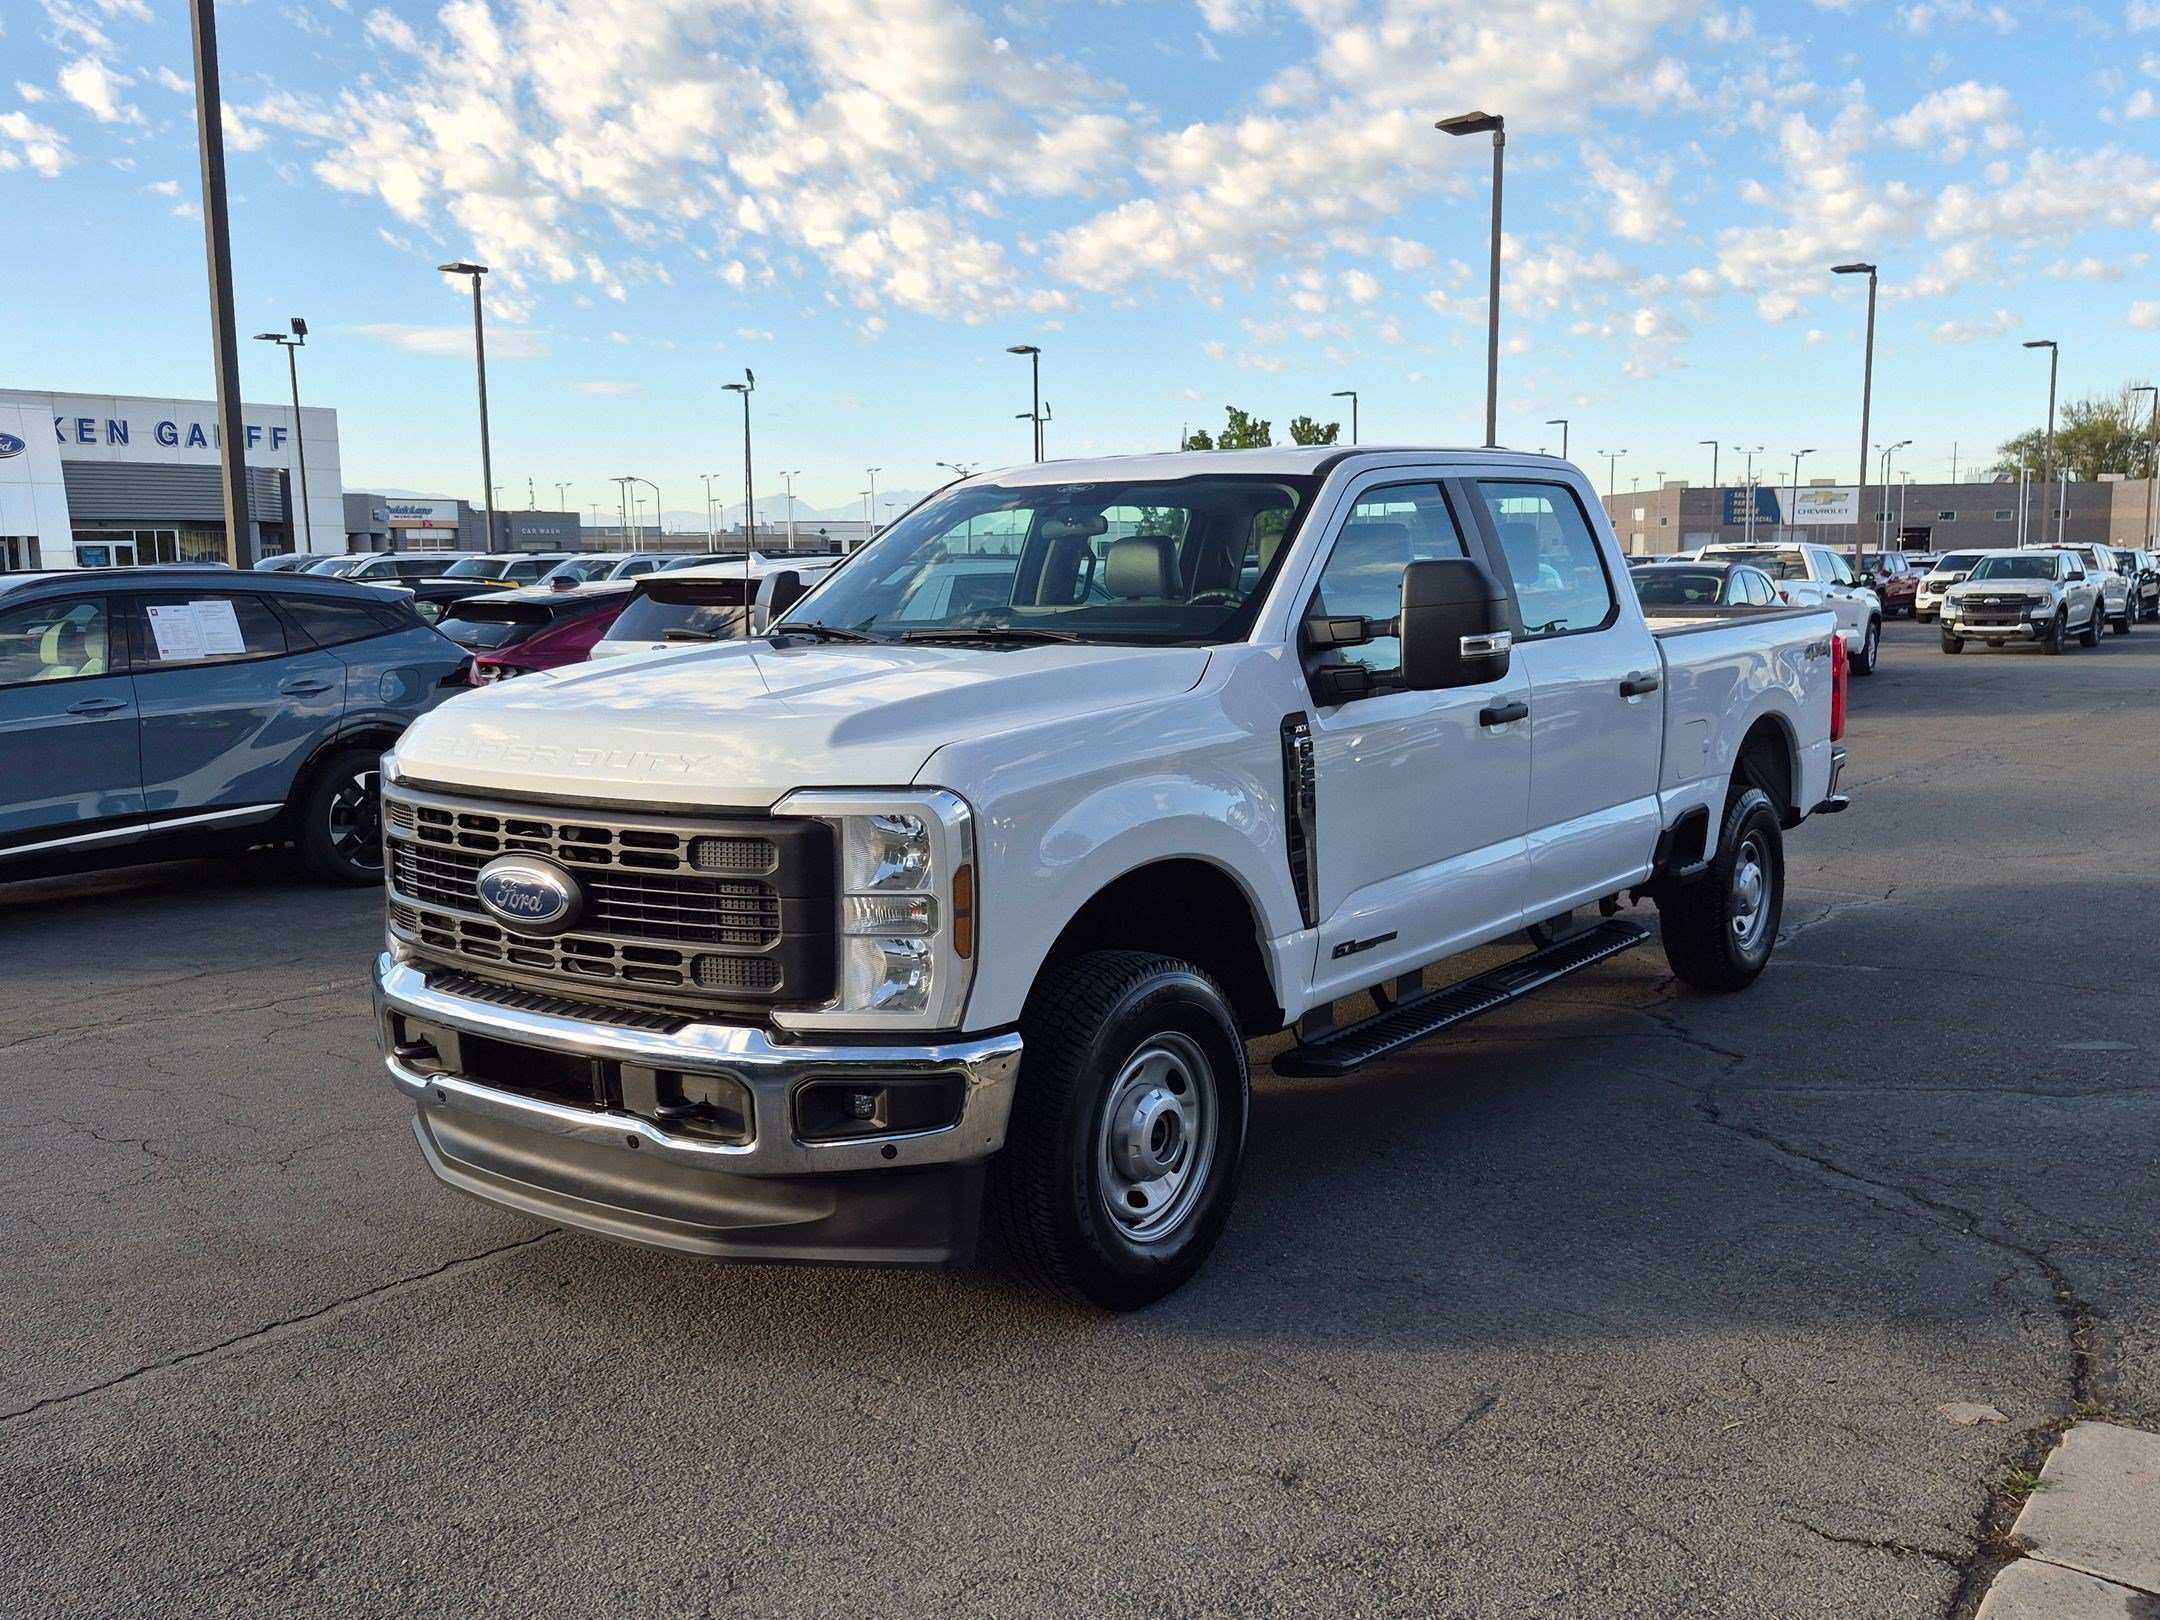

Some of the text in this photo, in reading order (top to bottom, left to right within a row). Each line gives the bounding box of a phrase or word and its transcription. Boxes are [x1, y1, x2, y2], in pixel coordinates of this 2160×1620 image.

[53, 416, 287, 450] KEN GAFF
[427, 735, 711, 773] SUPER DUTY
[495, 877, 545, 913] Ford
